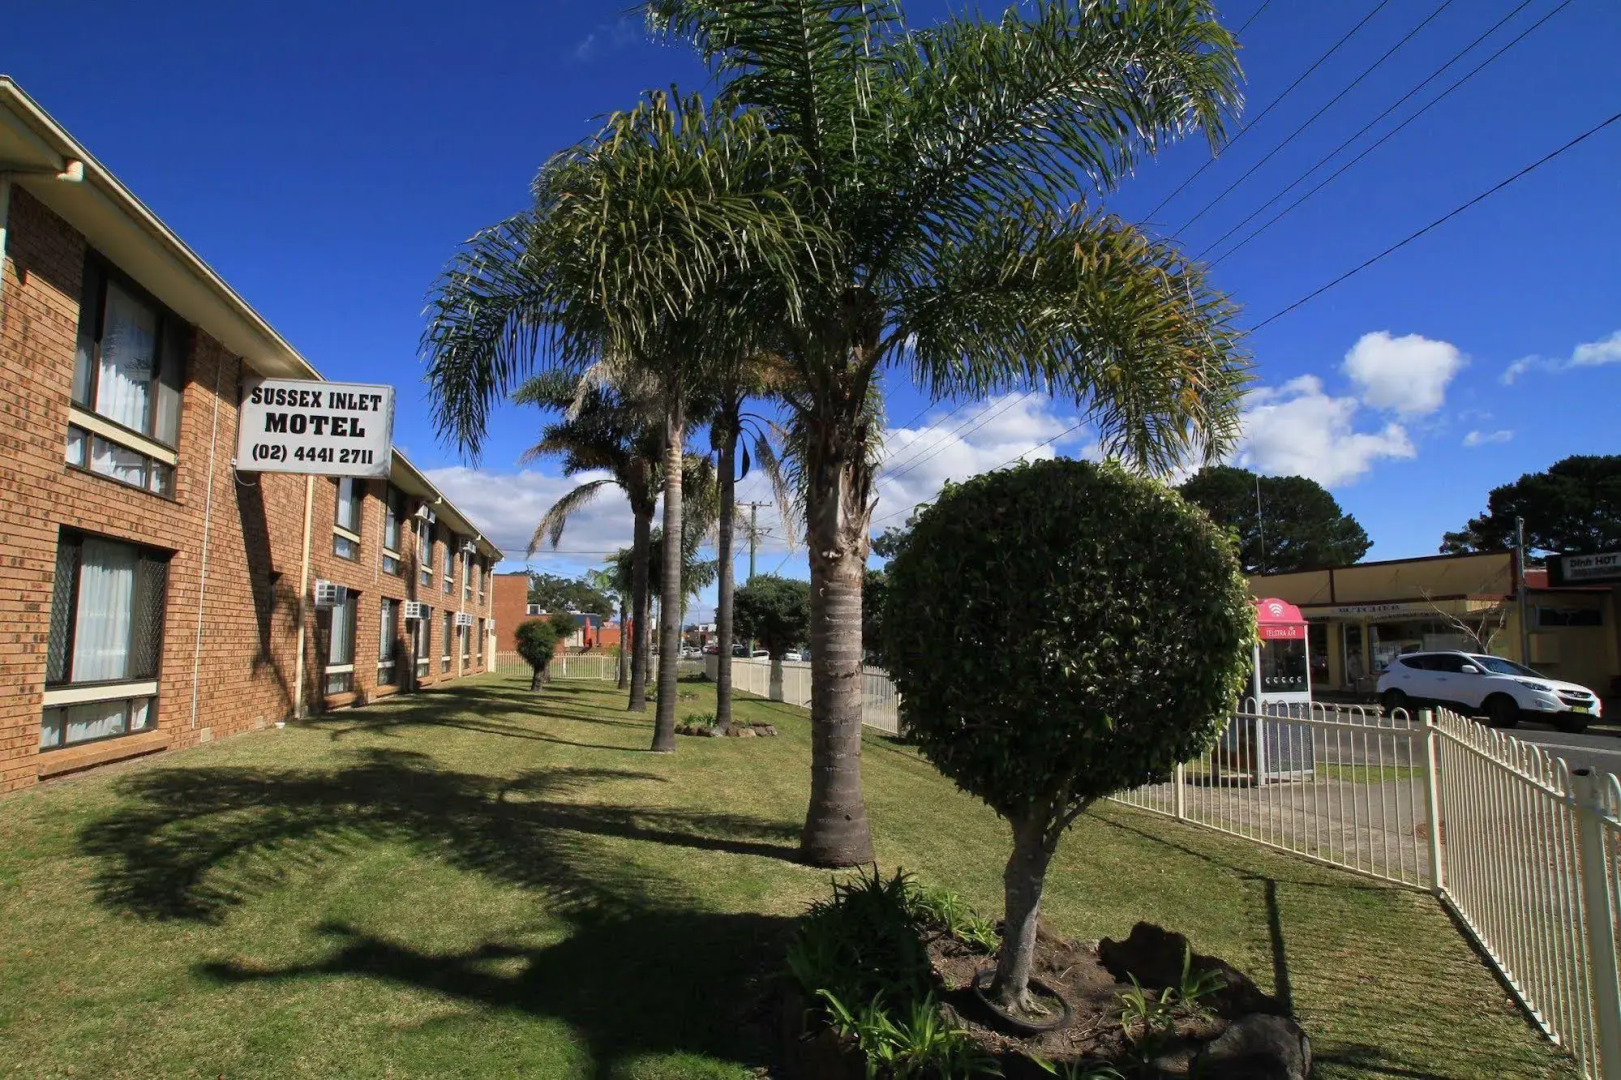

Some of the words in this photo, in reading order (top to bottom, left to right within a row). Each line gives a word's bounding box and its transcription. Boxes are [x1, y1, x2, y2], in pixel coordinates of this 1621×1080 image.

[251, 387, 322, 408] SUSSEX
[329, 391, 382, 412] INLET
[264, 412, 365, 438] MOTEL
[252, 443, 287, 462] (02)
[294, 446, 334, 463] 4441
[339, 448, 373, 465] 2711
[1266, 629, 1286, 637] TELSTRA
